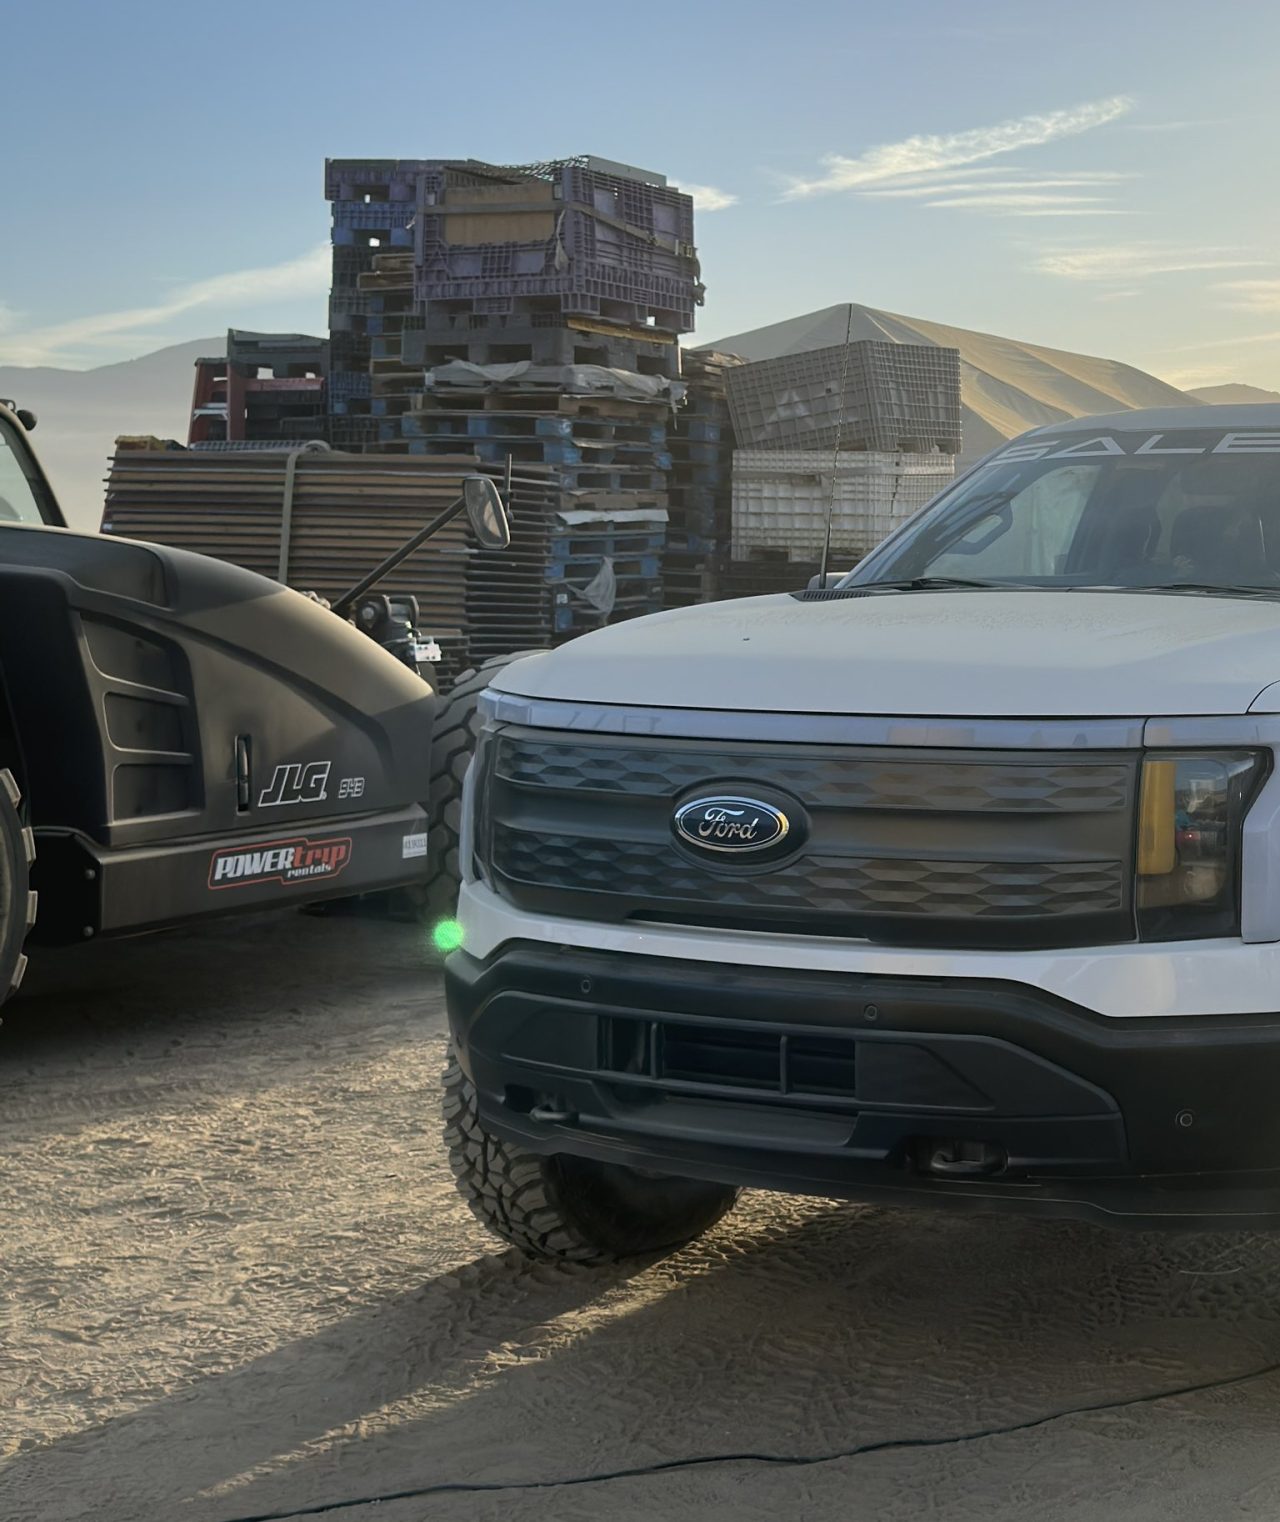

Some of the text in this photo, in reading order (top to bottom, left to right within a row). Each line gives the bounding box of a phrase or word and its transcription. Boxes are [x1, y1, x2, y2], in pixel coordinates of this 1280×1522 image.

[258, 761, 331, 807] JLG
[698, 807, 760, 840] Ford
[287, 863, 332, 878] rentals
